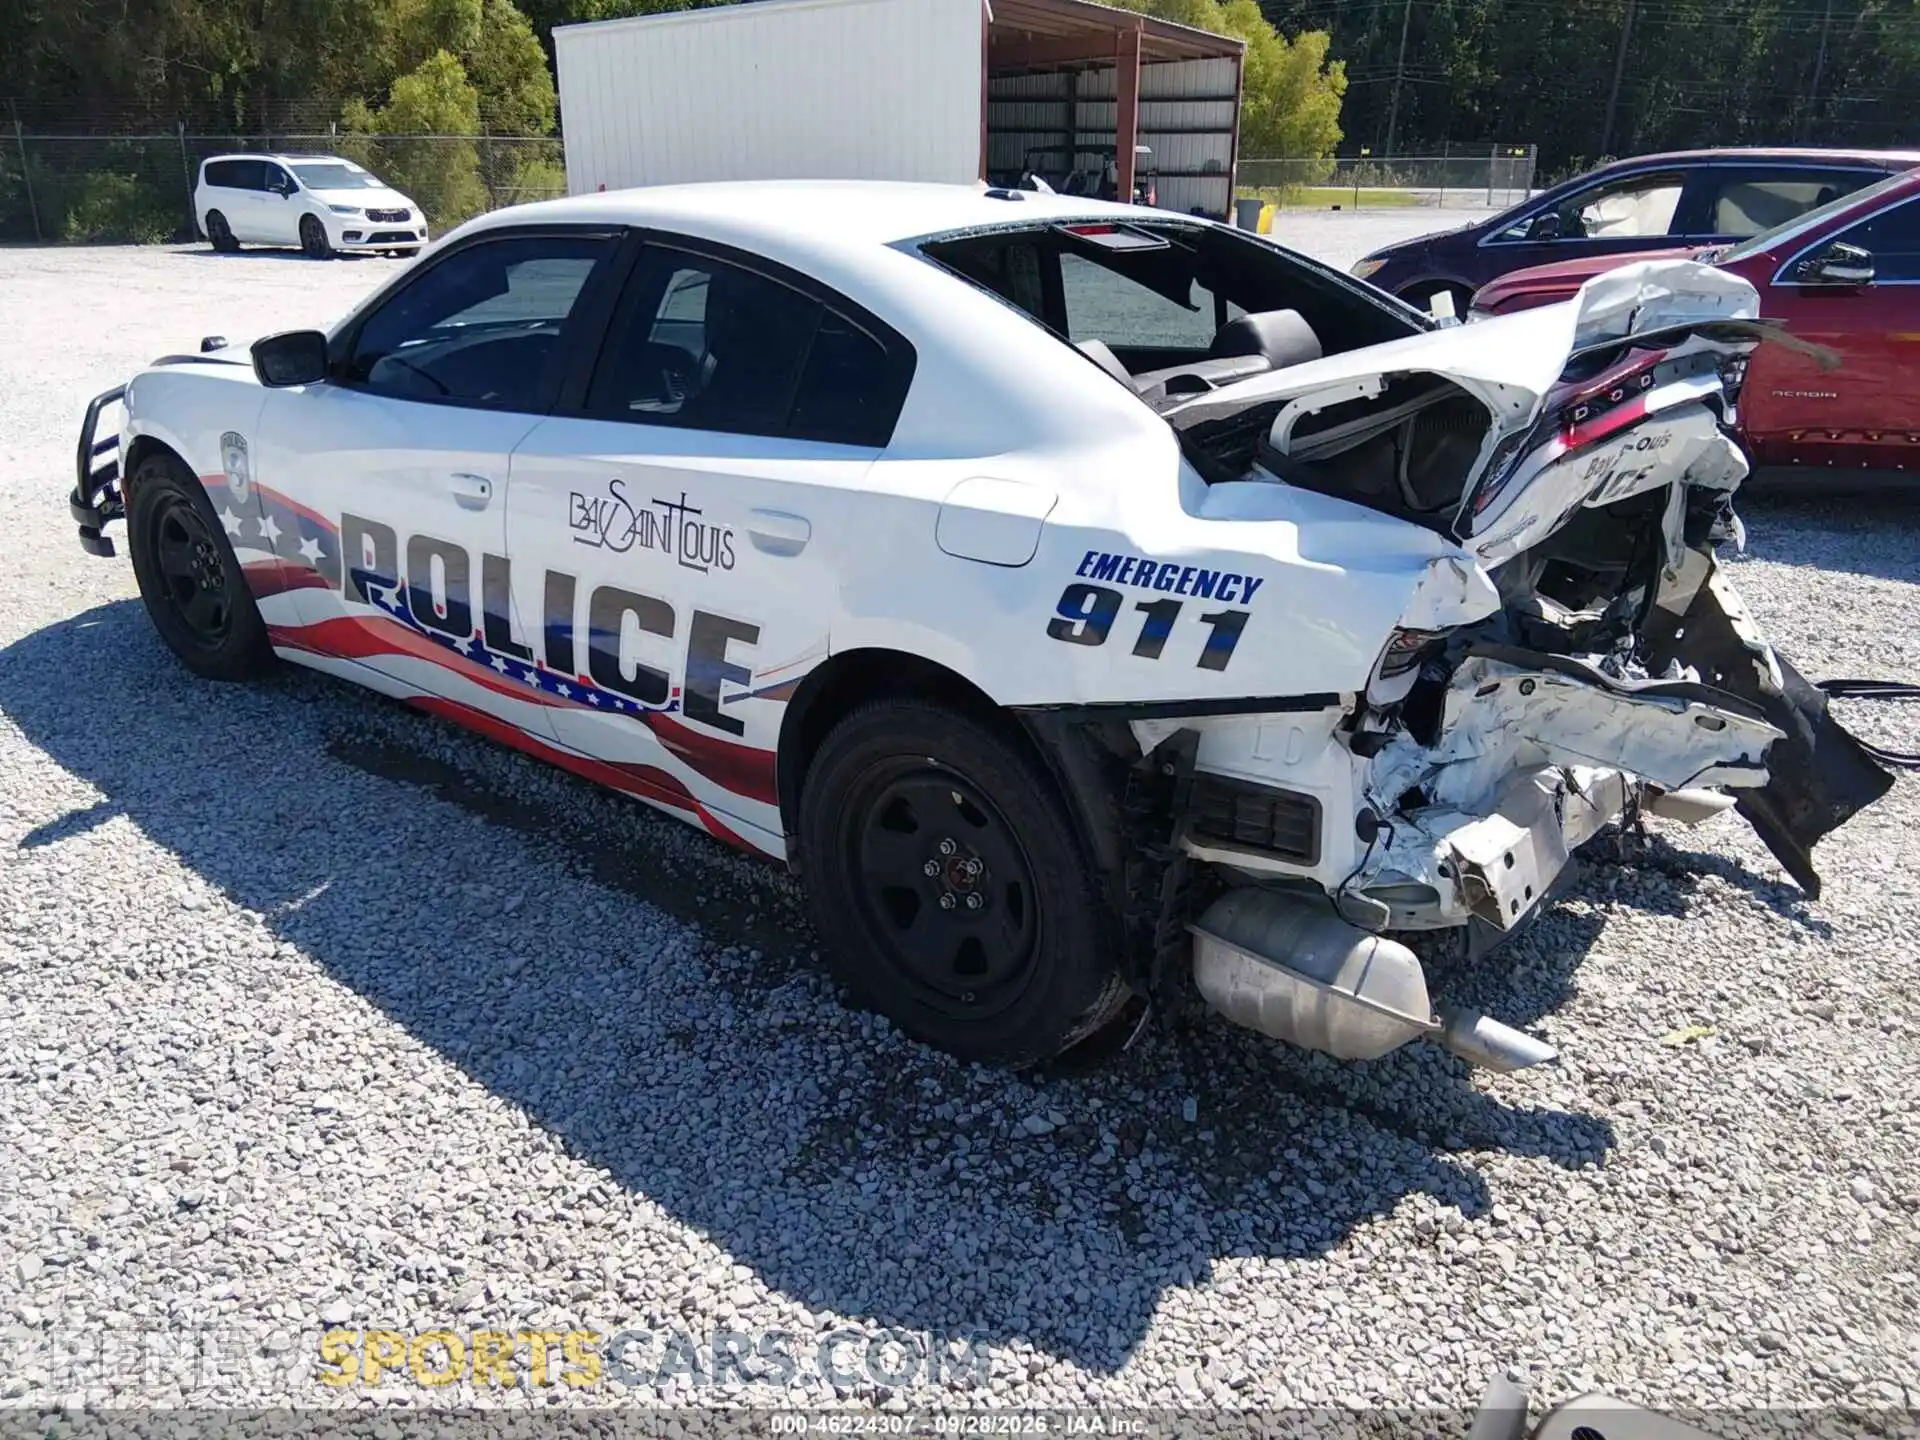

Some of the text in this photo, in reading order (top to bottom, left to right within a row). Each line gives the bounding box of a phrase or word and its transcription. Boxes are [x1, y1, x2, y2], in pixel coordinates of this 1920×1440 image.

[1772, 389, 1837, 399] ACADIA
[1075, 551, 1264, 604] EMERGENCY
[341, 512, 762, 738] POLICE
[1046, 583, 1252, 672] 911
